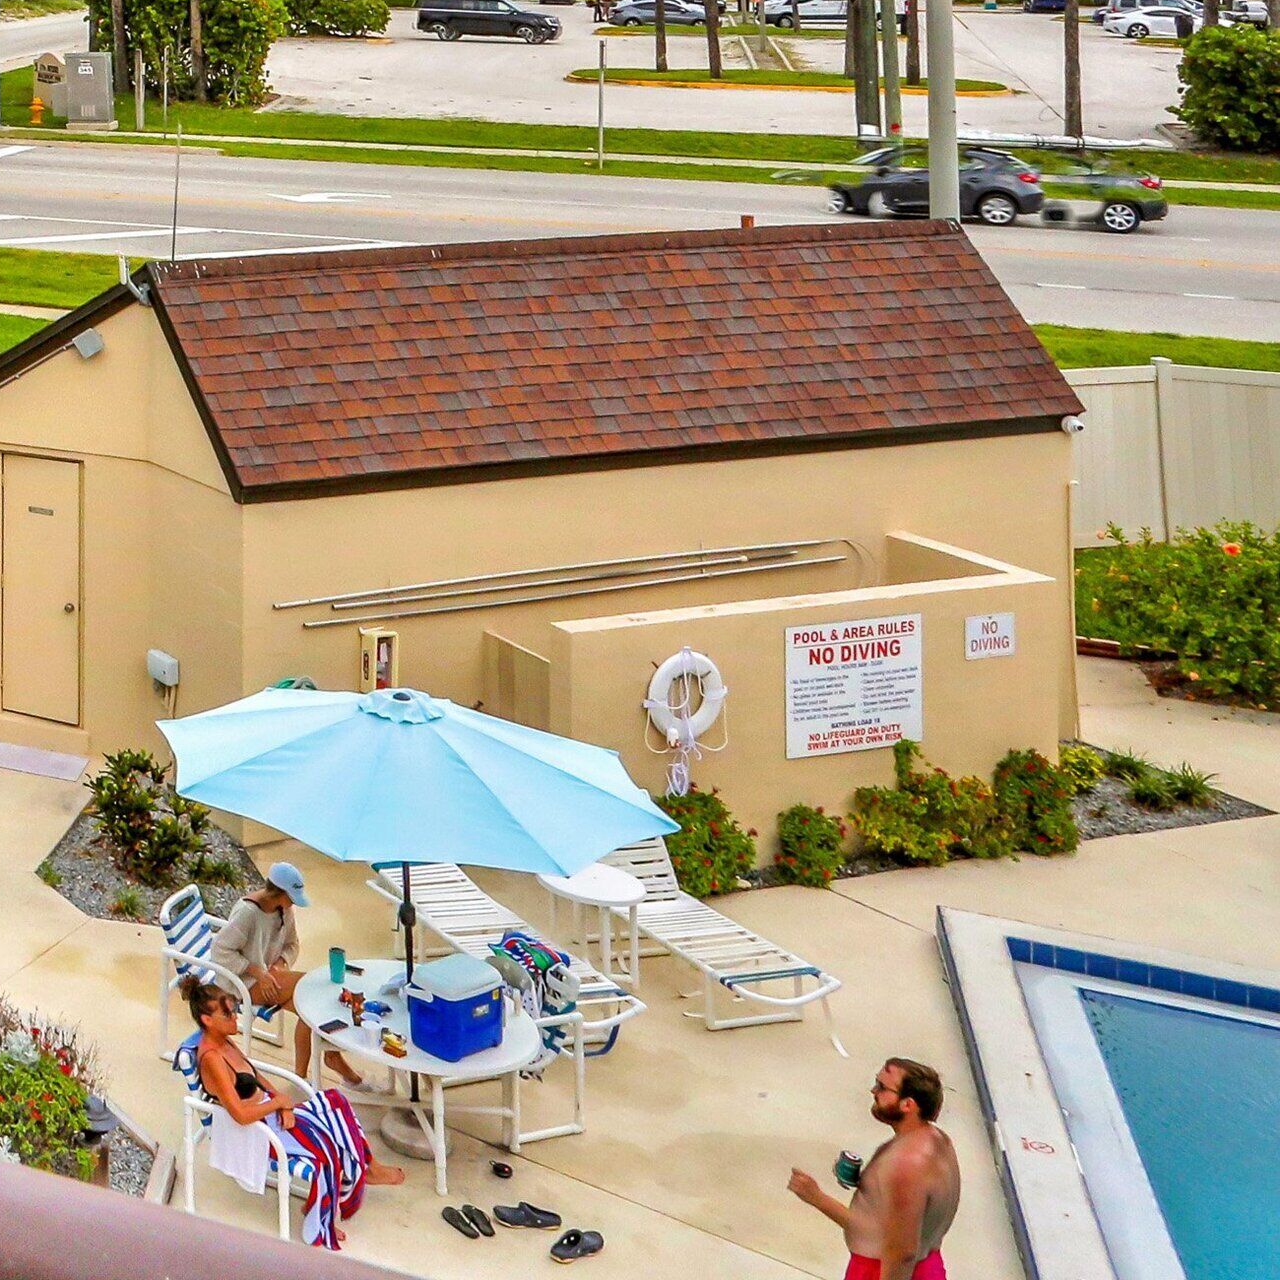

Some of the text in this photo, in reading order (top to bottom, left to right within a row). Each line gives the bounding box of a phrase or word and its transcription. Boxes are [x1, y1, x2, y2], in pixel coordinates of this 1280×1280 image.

[793, 620, 915, 645] POOL & AREA RULES
[981, 620, 998, 635] NO
[808, 639, 901, 666] NO DIVING
[970, 635, 1010, 652] DIVING
[808, 732, 903, 751] SWIM AT YOUR OWN RISK
[809, 724, 901, 742] NO LIFEGUARD ON DUTY
